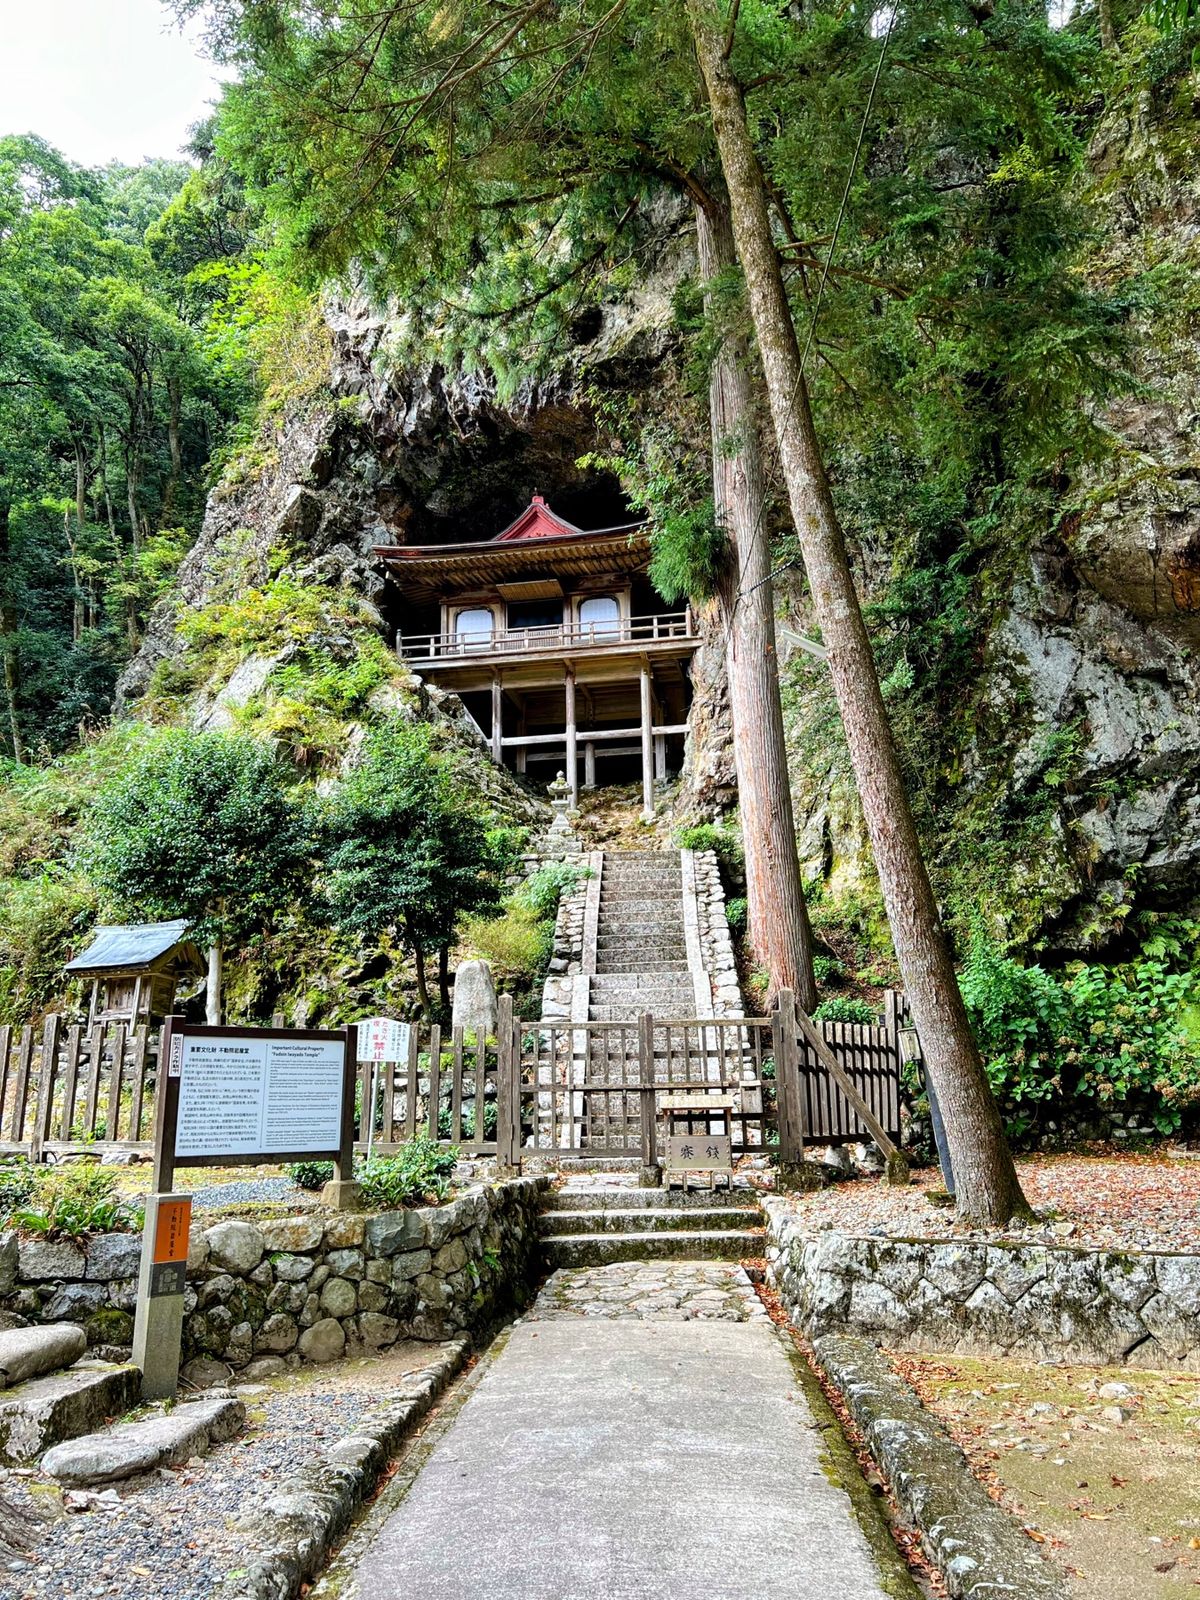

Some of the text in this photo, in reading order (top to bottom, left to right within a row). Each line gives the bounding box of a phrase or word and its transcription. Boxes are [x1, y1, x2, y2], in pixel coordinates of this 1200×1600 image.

[172, 1036, 181, 1073] 防犯カメラ作動中
[373, 1042, 385, 1059] 禁止
